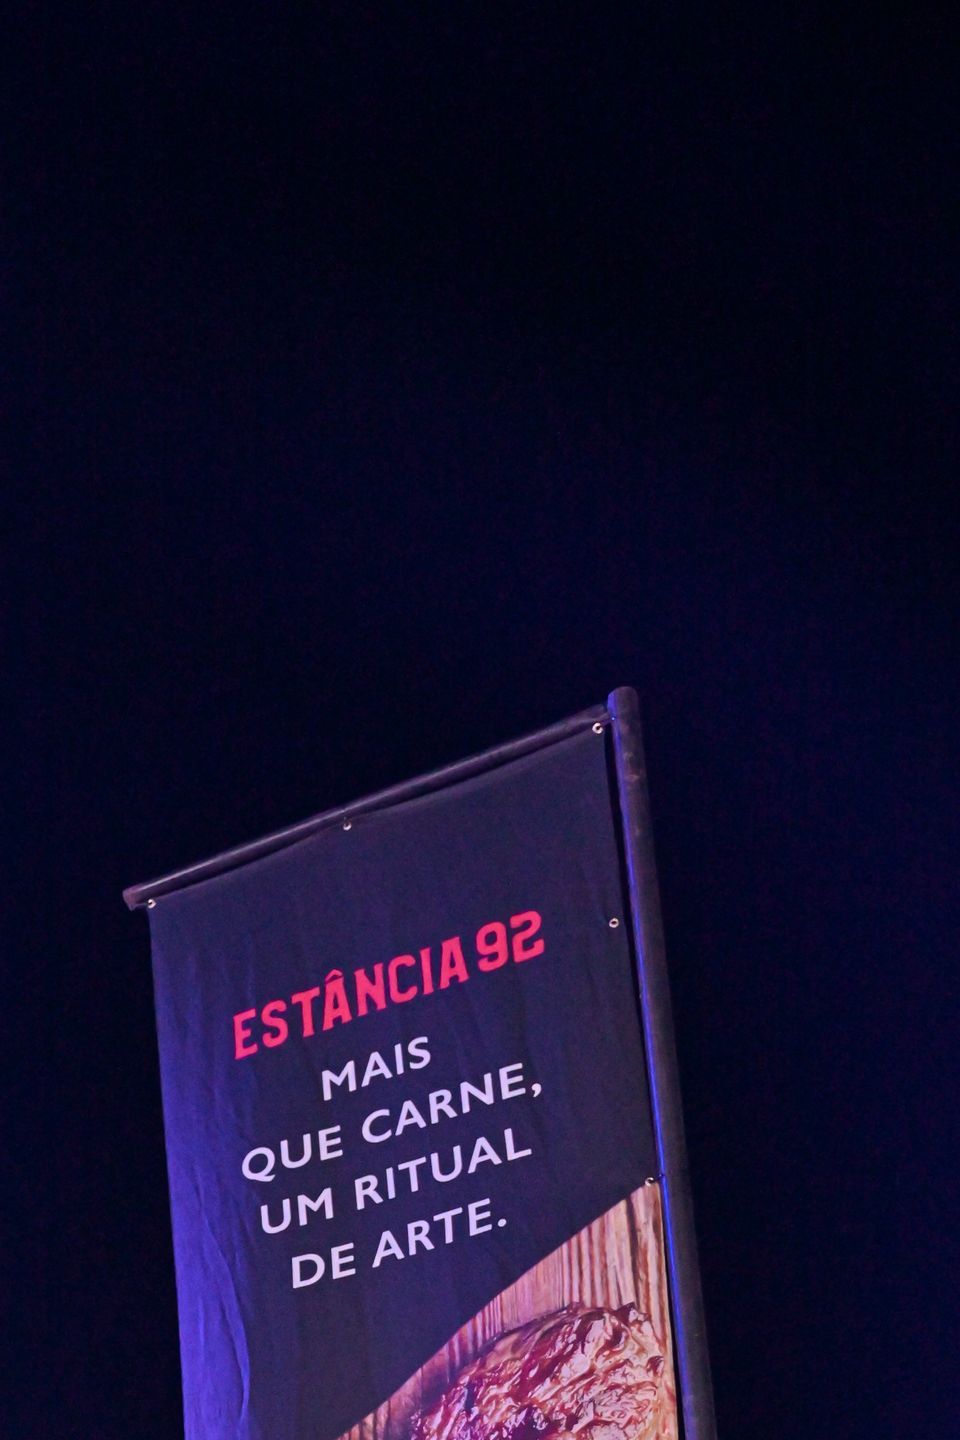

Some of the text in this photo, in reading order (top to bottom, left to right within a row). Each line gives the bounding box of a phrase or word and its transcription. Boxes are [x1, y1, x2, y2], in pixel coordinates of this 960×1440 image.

[233, 911, 544, 1059] ESTÂNCIA 92
[322, 1037, 431, 1100] MAIS
[242, 1063, 542, 1182] QUE CARNE,
[261, 1128, 532, 1235] UM RITUAL
[292, 1198, 507, 1289] DE ARTE.
